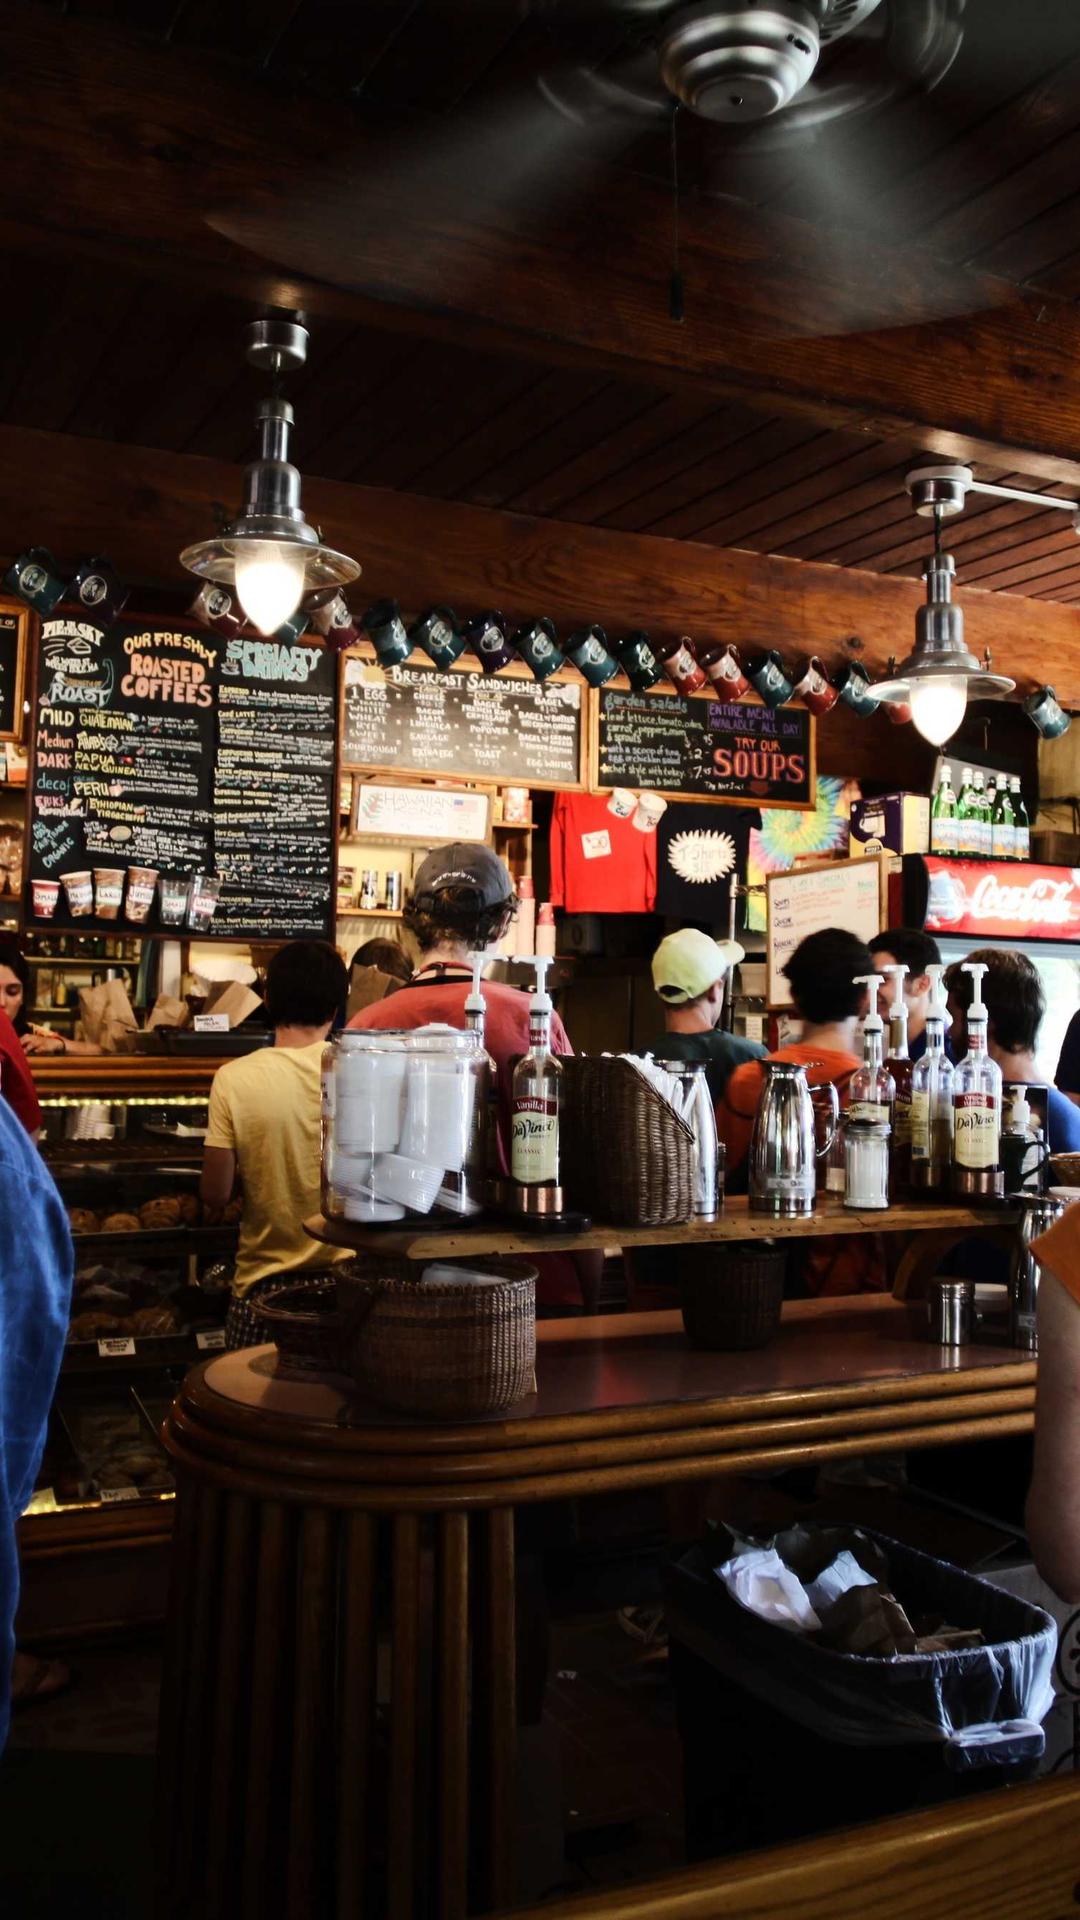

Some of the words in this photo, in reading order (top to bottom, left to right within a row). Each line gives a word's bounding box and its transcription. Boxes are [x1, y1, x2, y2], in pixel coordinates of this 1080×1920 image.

[123, 632, 152, 655] OUR
[153, 632, 217, 668] FRESHLY
[226, 639, 323, 671] SPECIALTY
[131, 653, 205, 684] ROASTED
[242, 659, 309, 682] DRINKS
[392, 665, 465, 687] BREAKFAST
[467, 673, 543, 695] SANDWICHES
[50, 682, 113, 707] ROAST
[121, 675, 212, 708] COFFEES
[351, 686, 359, 699] 1
[363, 688, 387, 700] EGG
[413, 692, 446, 701] CHEESE
[473, 699, 503, 709] BAGEL
[534, 696, 563, 707] BAGEL
[605, 692, 646, 710] garden
[650, 697, 688, 713] salads
[40, 708, 75, 727] MILD
[416, 707, 445, 715] BACON
[518, 711, 543, 721] BAGEL
[607, 710, 625, 721] leaf
[709, 703, 743, 717] ENTIRE
[747, 707, 775, 720] MENU
[348, 712, 387, 724] WHEAT
[419, 714, 442, 723] HAM
[356, 722, 377, 731] RYE
[710, 718, 755, 732] AVAILABLE
[761, 722, 778, 733] ALL
[783, 723, 799, 734] DAY
[349, 729, 386, 741] SWEET
[410, 732, 449, 741] SAUSAGE
[518, 733, 540, 743] BAGEL
[614, 733, 641, 747] sprouts
[342, 741, 398, 754] SOURDOUGH
[735, 736, 757, 749] TRY
[760, 740, 780, 752] OUR
[440, 749, 453, 758] EGG
[473, 749, 502, 759] TOAST
[607, 745, 623, 753] with
[632, 747, 656, 758] scoop
[656, 745, 663, 754] of
[37, 751, 72, 769] DARK
[75, 751, 115, 765] PAPUA
[526, 757, 543, 768] EGG
[608, 754, 624, 764] egg
[632, 755, 661, 763] chicken
[713, 748, 805, 783] SOUPS
[75, 762, 100, 771] NEW
[101, 763, 136, 776] GUINEA
[608, 763, 626, 773] chef
[628, 764, 646, 777] style
[648, 765, 663, 775] with
[37, 772, 70, 796] decaf
[73, 782, 109, 796] PERU
[639, 776, 656, 786] ham
[663, 777, 681, 786] swiss
[89, 797, 133, 811] ETHIOPIAN
[217, 871, 239, 882] TEA
[516, 1101, 544, 1111] Vanilla
[511, 1118, 556, 1141] DaVinci
